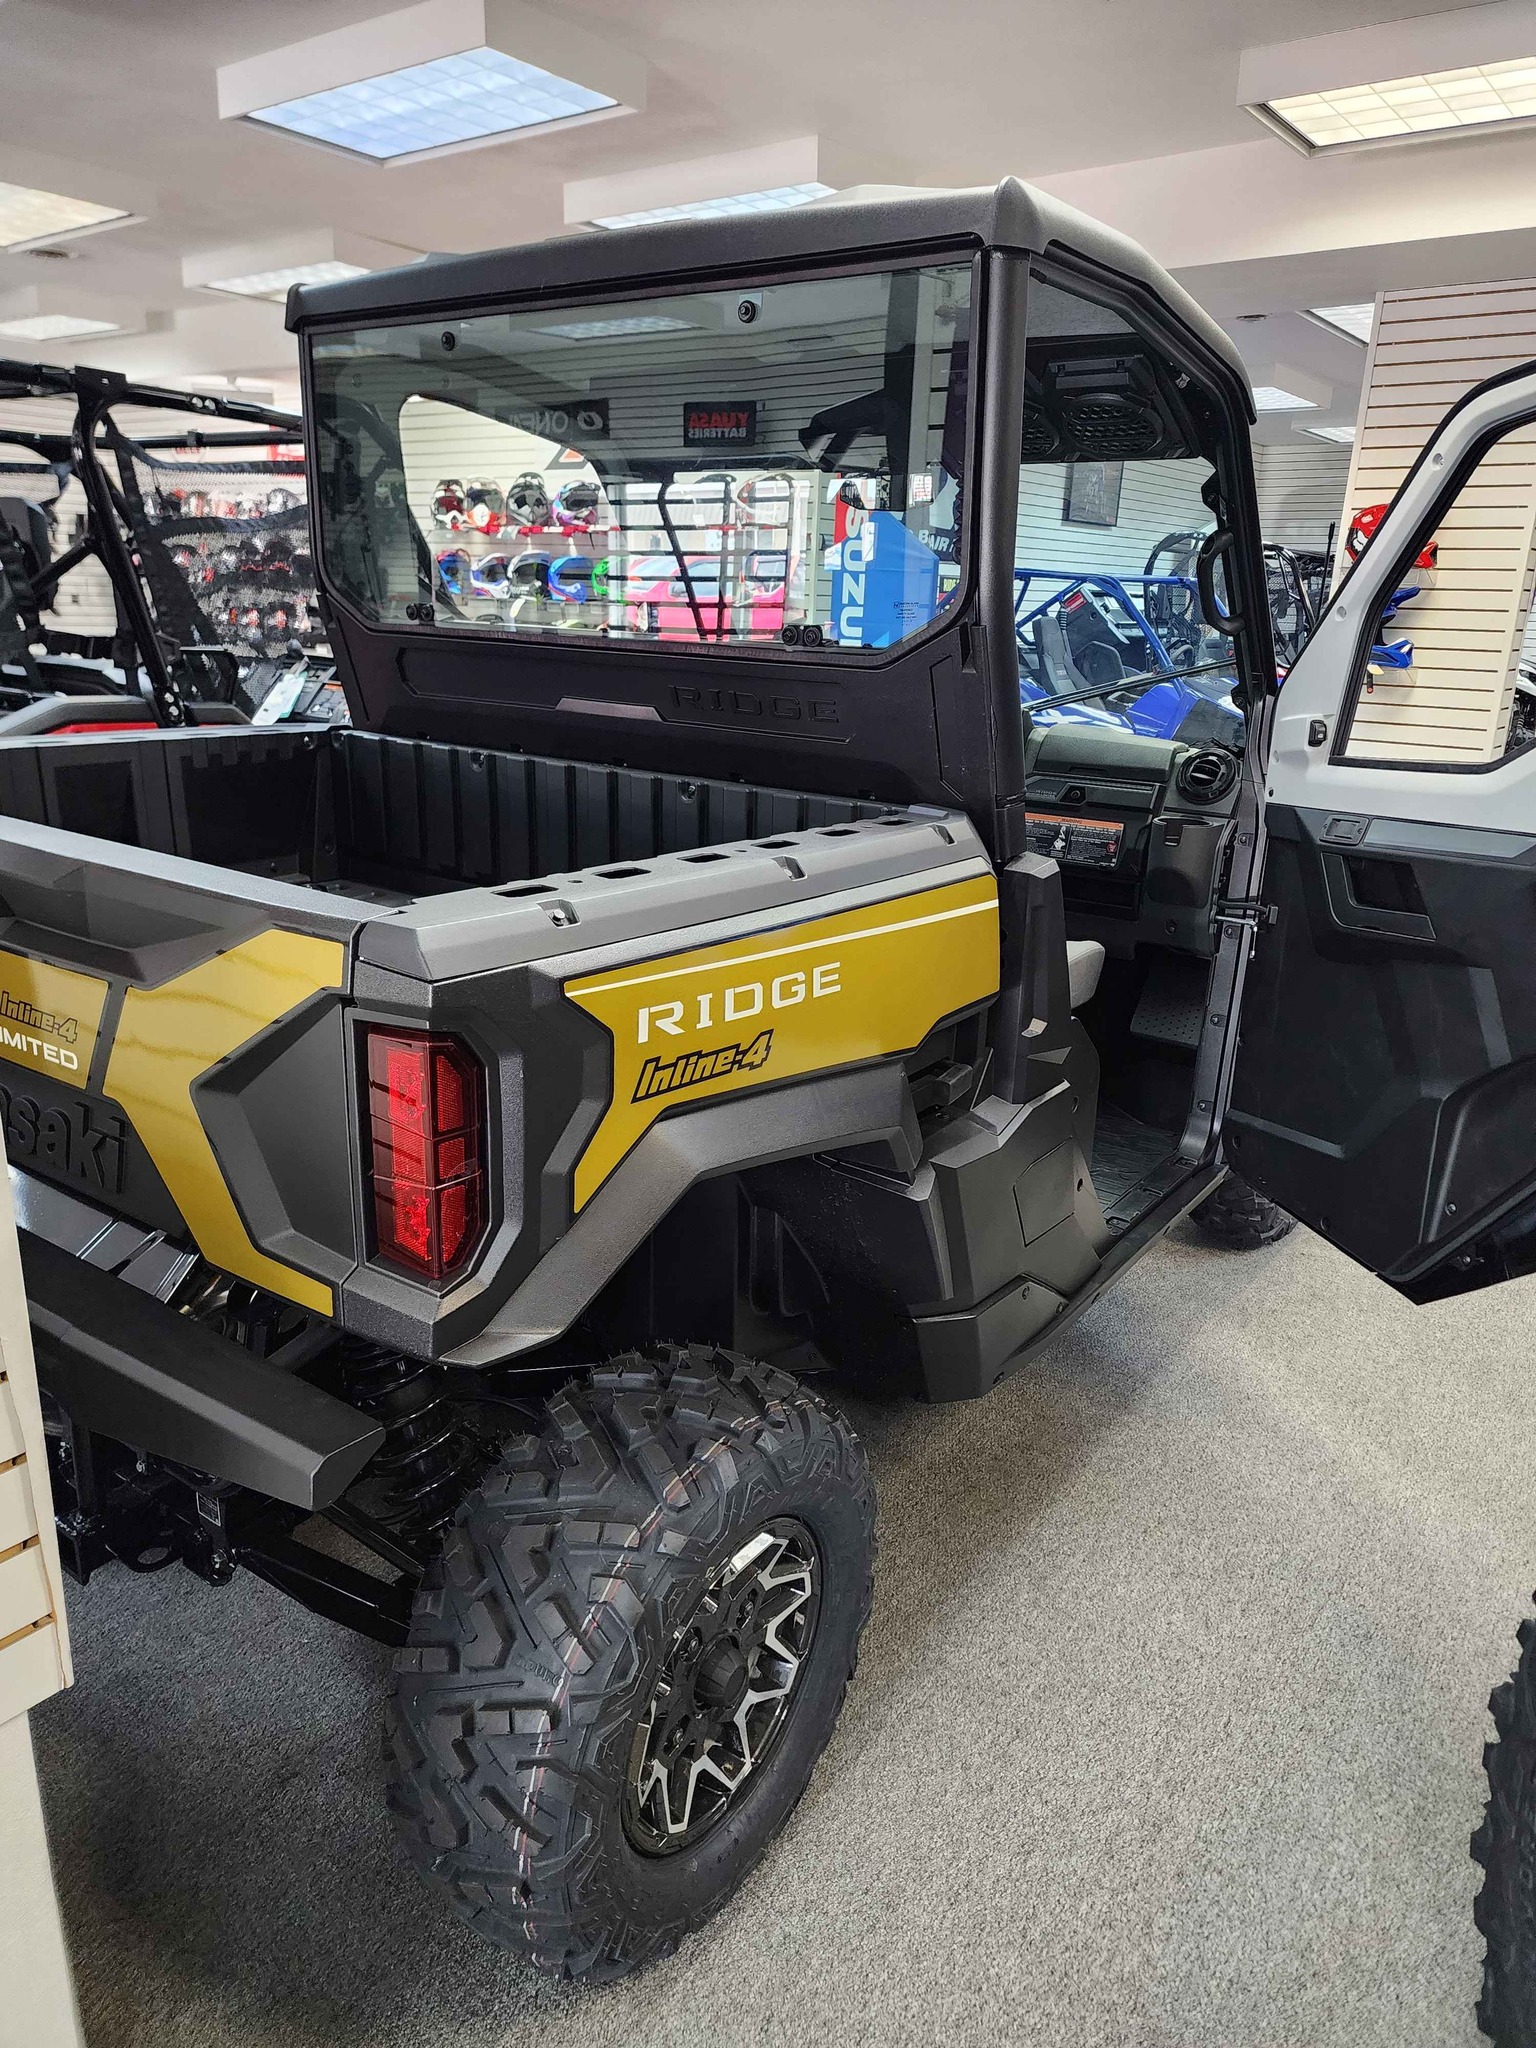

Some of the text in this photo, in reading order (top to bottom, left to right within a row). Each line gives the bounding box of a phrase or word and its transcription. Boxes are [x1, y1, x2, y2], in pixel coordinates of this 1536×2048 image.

[668, 684, 840, 724] RIDGE
[0, 990, 78, 1044] Inline-4
[638, 961, 841, 1044] RIDGE
[630, 1028, 774, 1104] Inline-4
